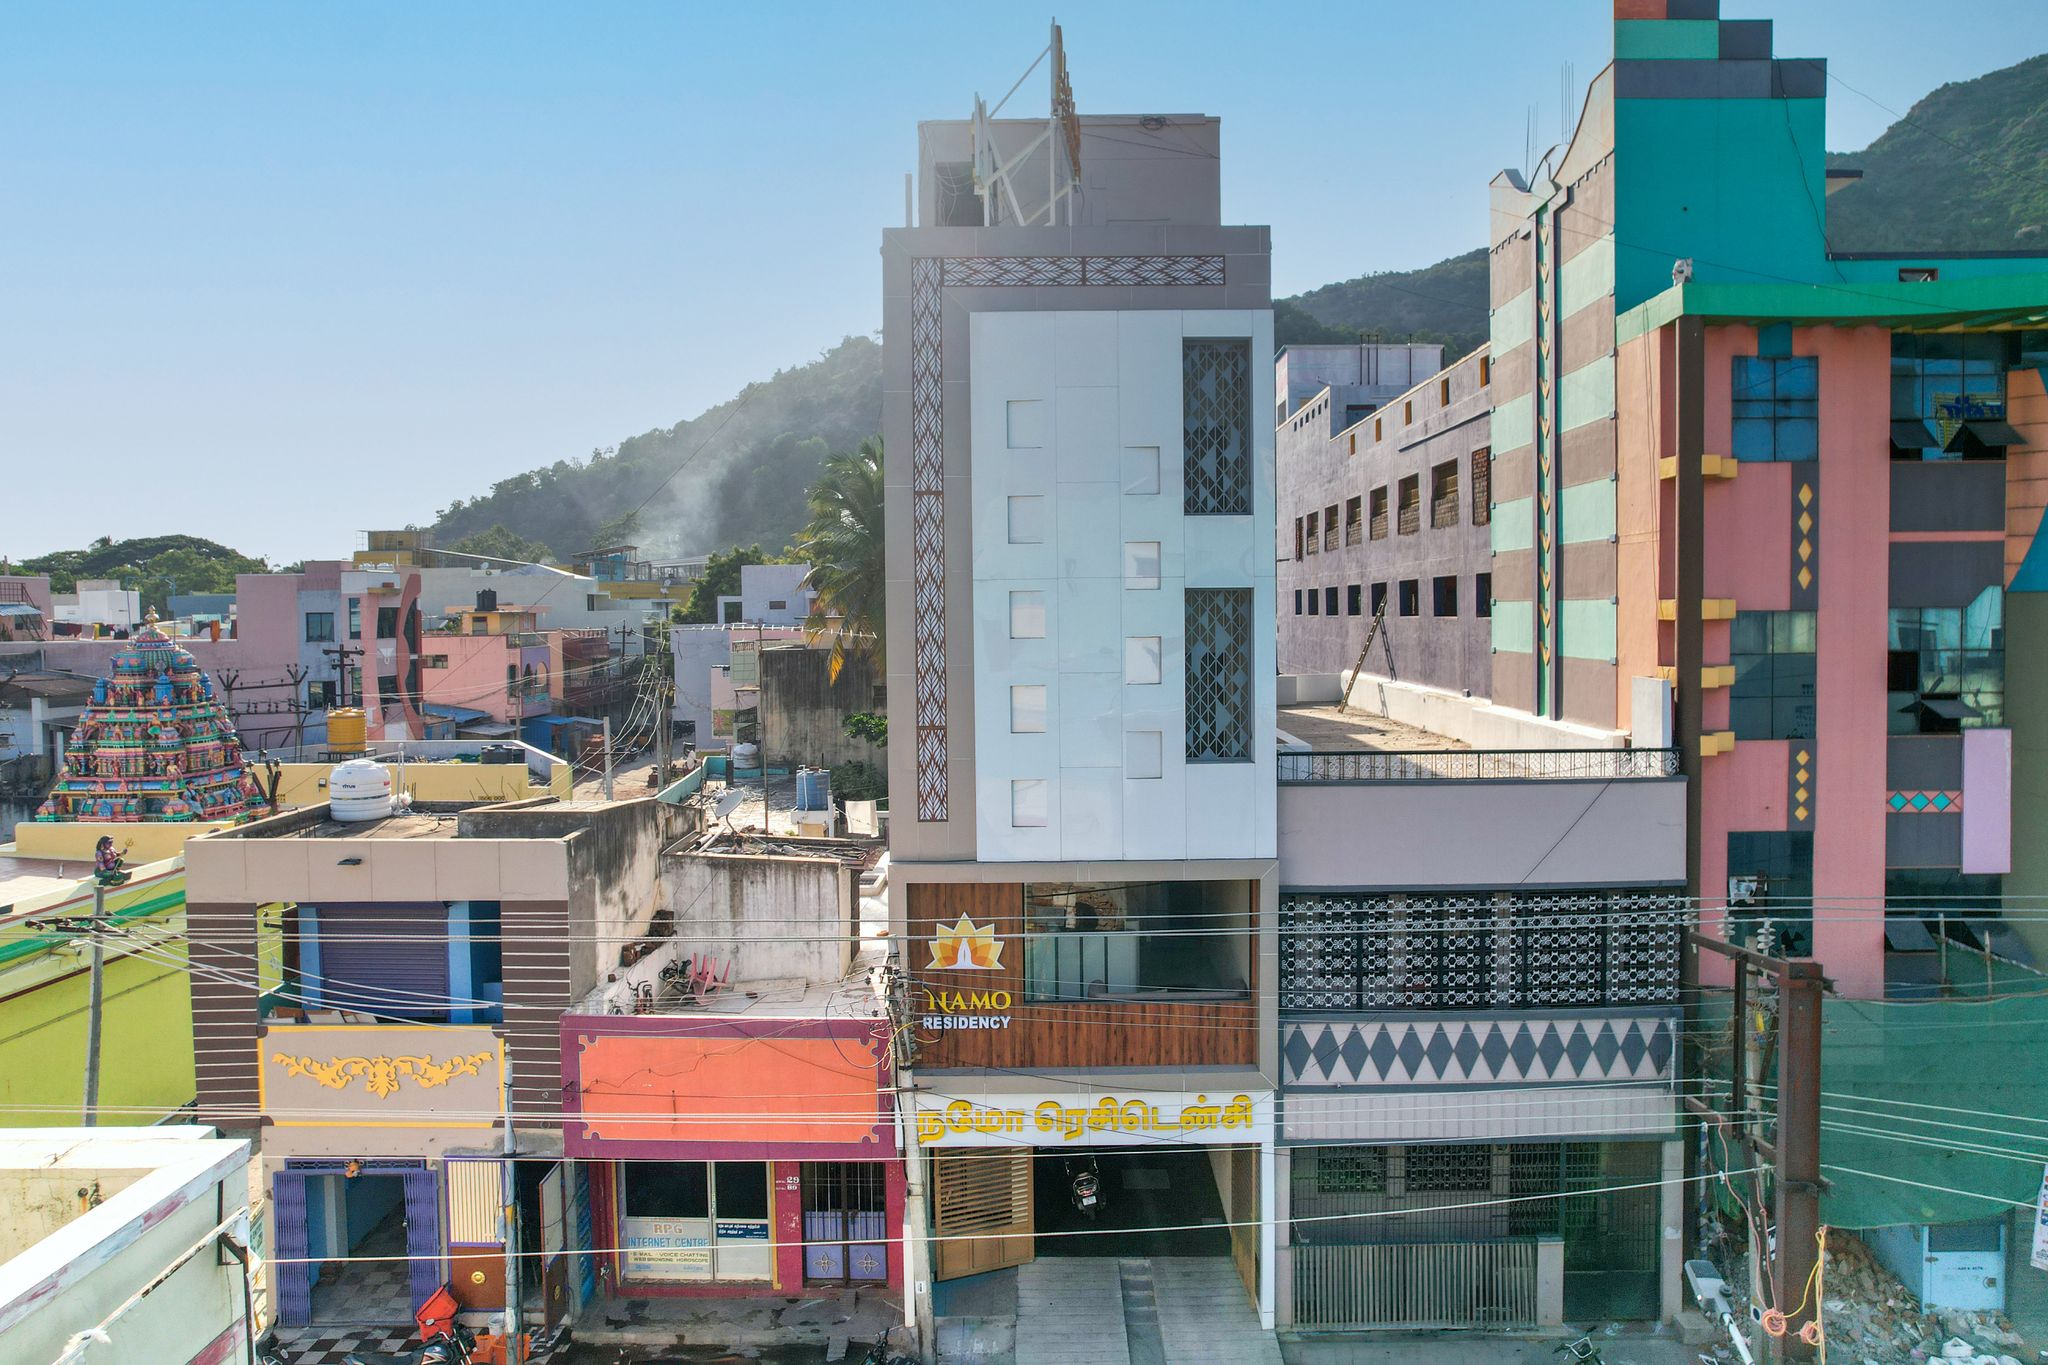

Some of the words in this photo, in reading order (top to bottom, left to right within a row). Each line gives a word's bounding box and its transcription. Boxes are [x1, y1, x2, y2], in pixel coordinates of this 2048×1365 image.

[922, 988, 1012, 1013] NAMO
[922, 1015, 1011, 1030] RESIDENCY
[917, 1100, 1024, 1144] நமோ
[1035, 1094, 1254, 1140] ரெசிடென்சி
[786, 1176, 800, 1184] 29
[654, 1223, 683, 1234] RPG
[628, 1236, 671, 1248] INTERNET
[674, 1237, 709, 1248] CENTRE
